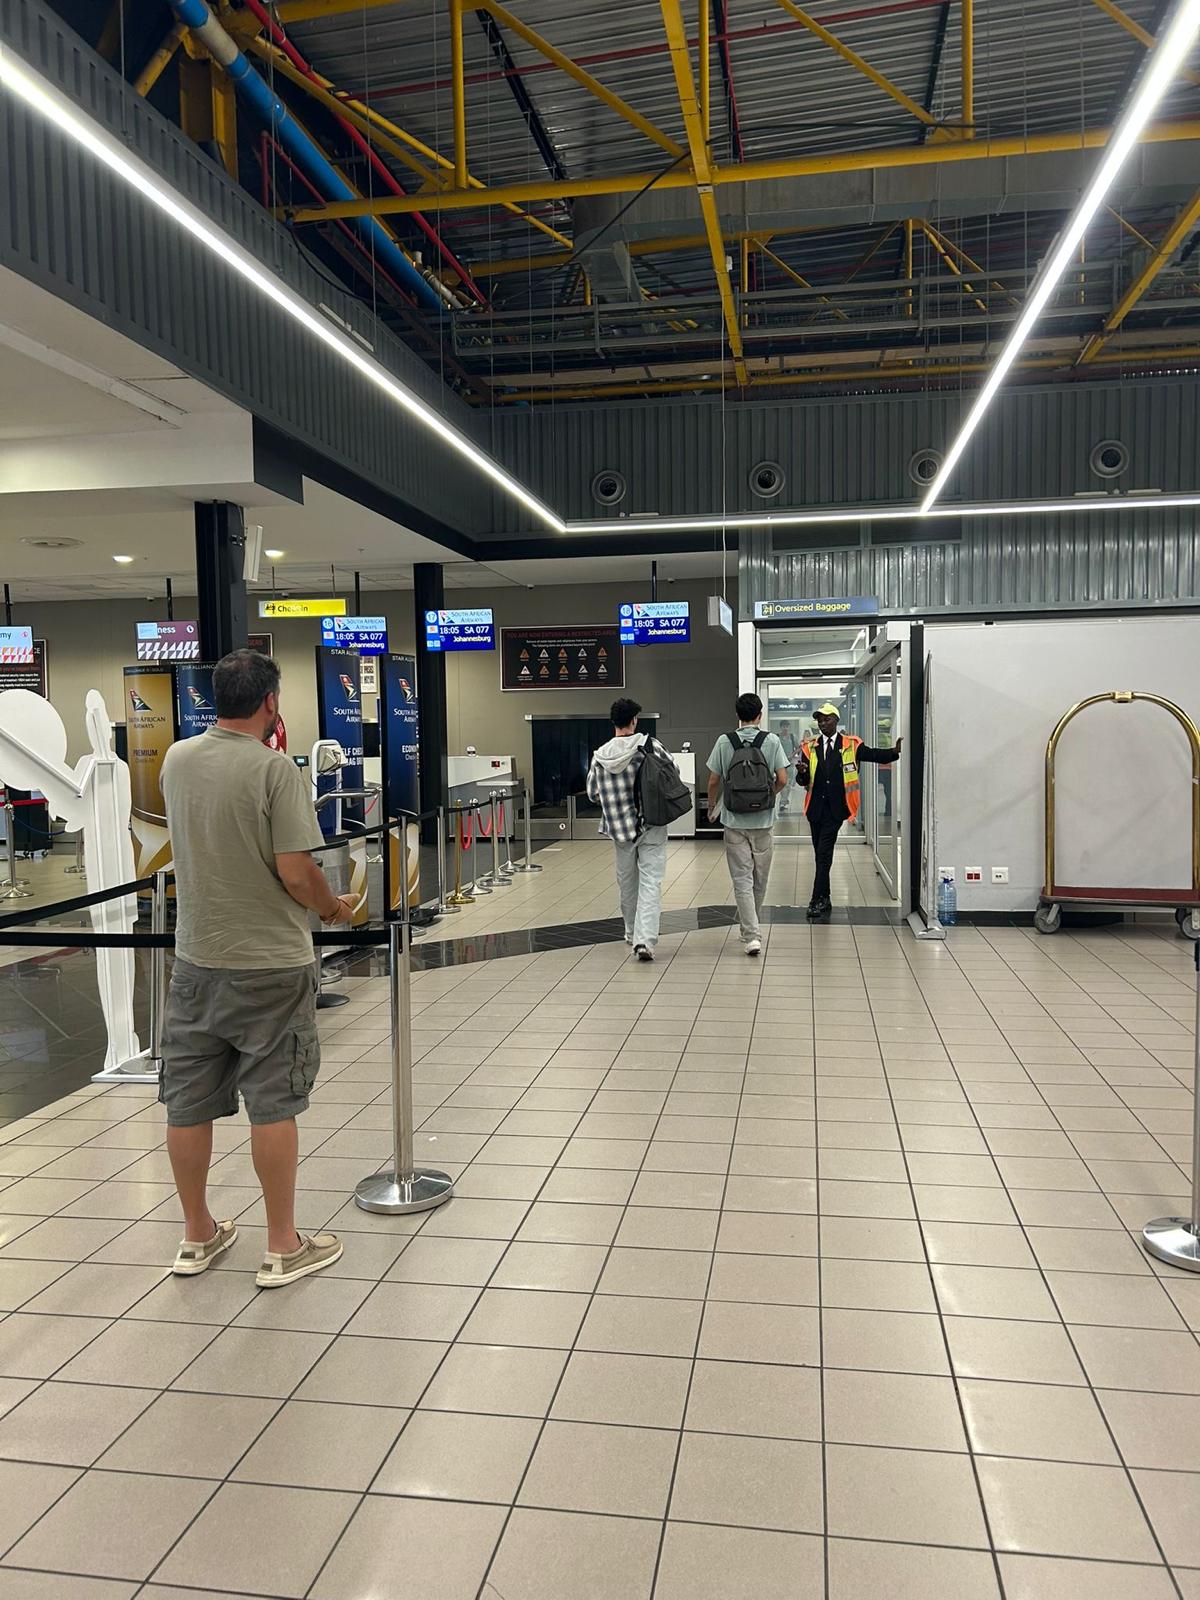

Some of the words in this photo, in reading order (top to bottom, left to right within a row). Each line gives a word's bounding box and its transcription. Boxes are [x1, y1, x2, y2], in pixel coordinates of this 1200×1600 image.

[775, 604, 813, 613] Oversized
[816, 603, 851, 612] Baggage
[634, 619, 655, 628] 18:05
[659, 619, 670, 627] SA
[671, 618, 685, 627] 077
[440, 626, 460, 635] 18:05
[464, 626, 475, 634] SA
[475, 625, 490, 634] 077
[647, 627, 687, 636] Johannesburg
[335, 632, 355, 641] 18:05
[359, 632, 369, 640] SA
[370, 632, 383, 641] 077
[453, 634, 492, 643] Johannesburg
[348, 641, 385, 649] Johannesburg
[333, 707, 355, 715] SOUTH
[393, 708, 411, 716] SOUTH
